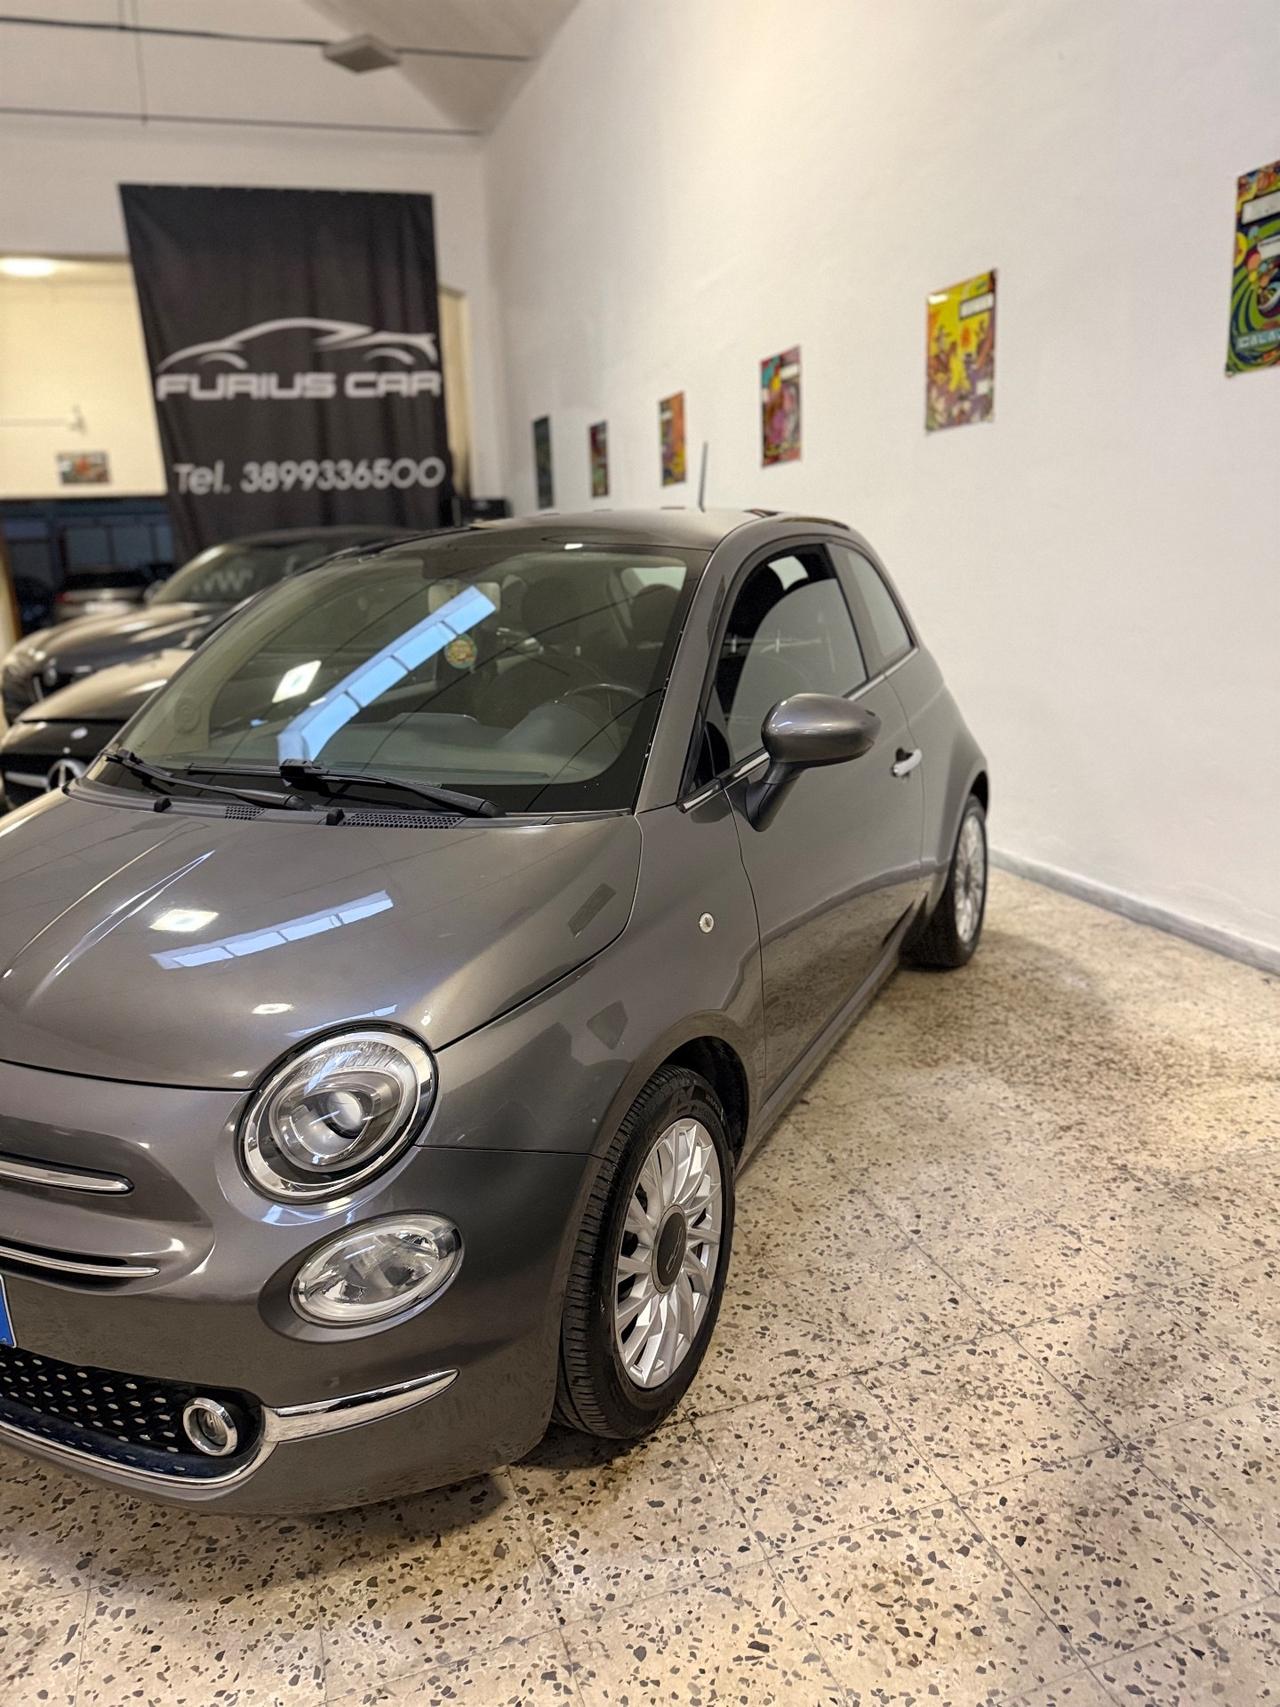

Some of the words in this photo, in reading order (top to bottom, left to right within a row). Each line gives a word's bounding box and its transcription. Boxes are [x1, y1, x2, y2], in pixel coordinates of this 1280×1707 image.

[156, 373, 337, 400] FURIUS
[346, 371, 442, 399] CAR
[173, 459, 231, 494] Tel.
[240, 456, 446, 493] 3899336500
